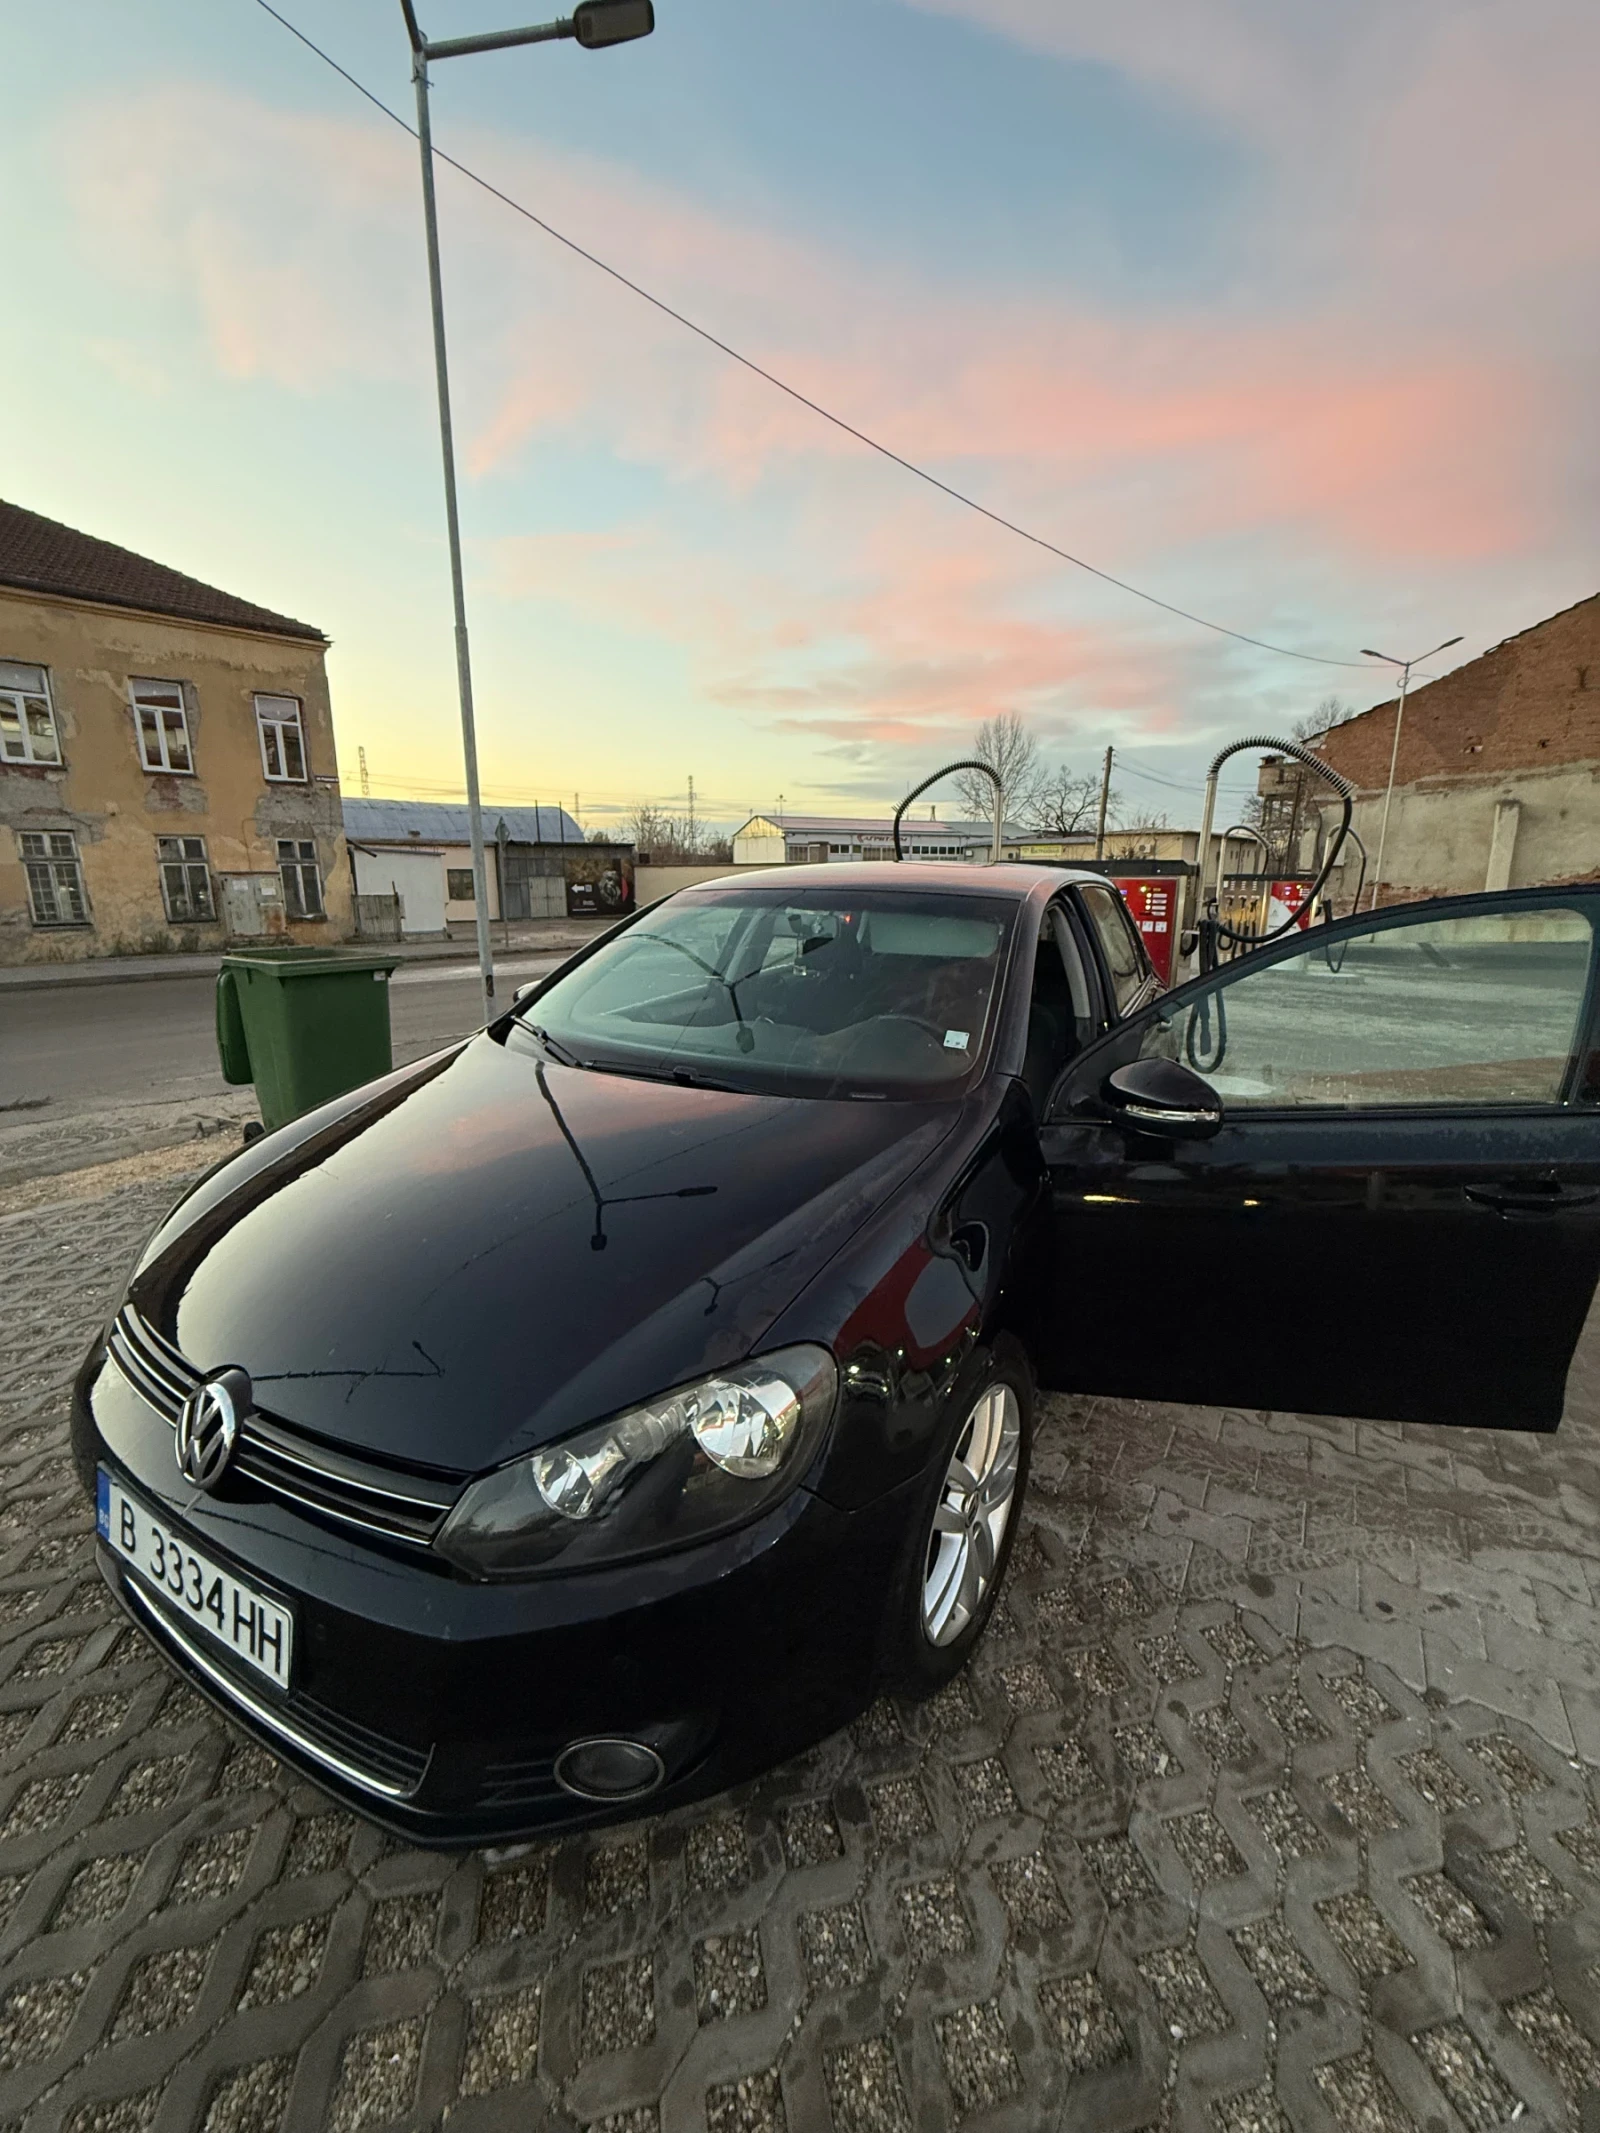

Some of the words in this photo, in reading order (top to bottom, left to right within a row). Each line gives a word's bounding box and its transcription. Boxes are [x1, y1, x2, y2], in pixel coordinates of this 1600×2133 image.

[121, 1498, 136, 1554] B
[150, 1527, 225, 1630] 3334
[233, 1588, 281, 1675] HH
